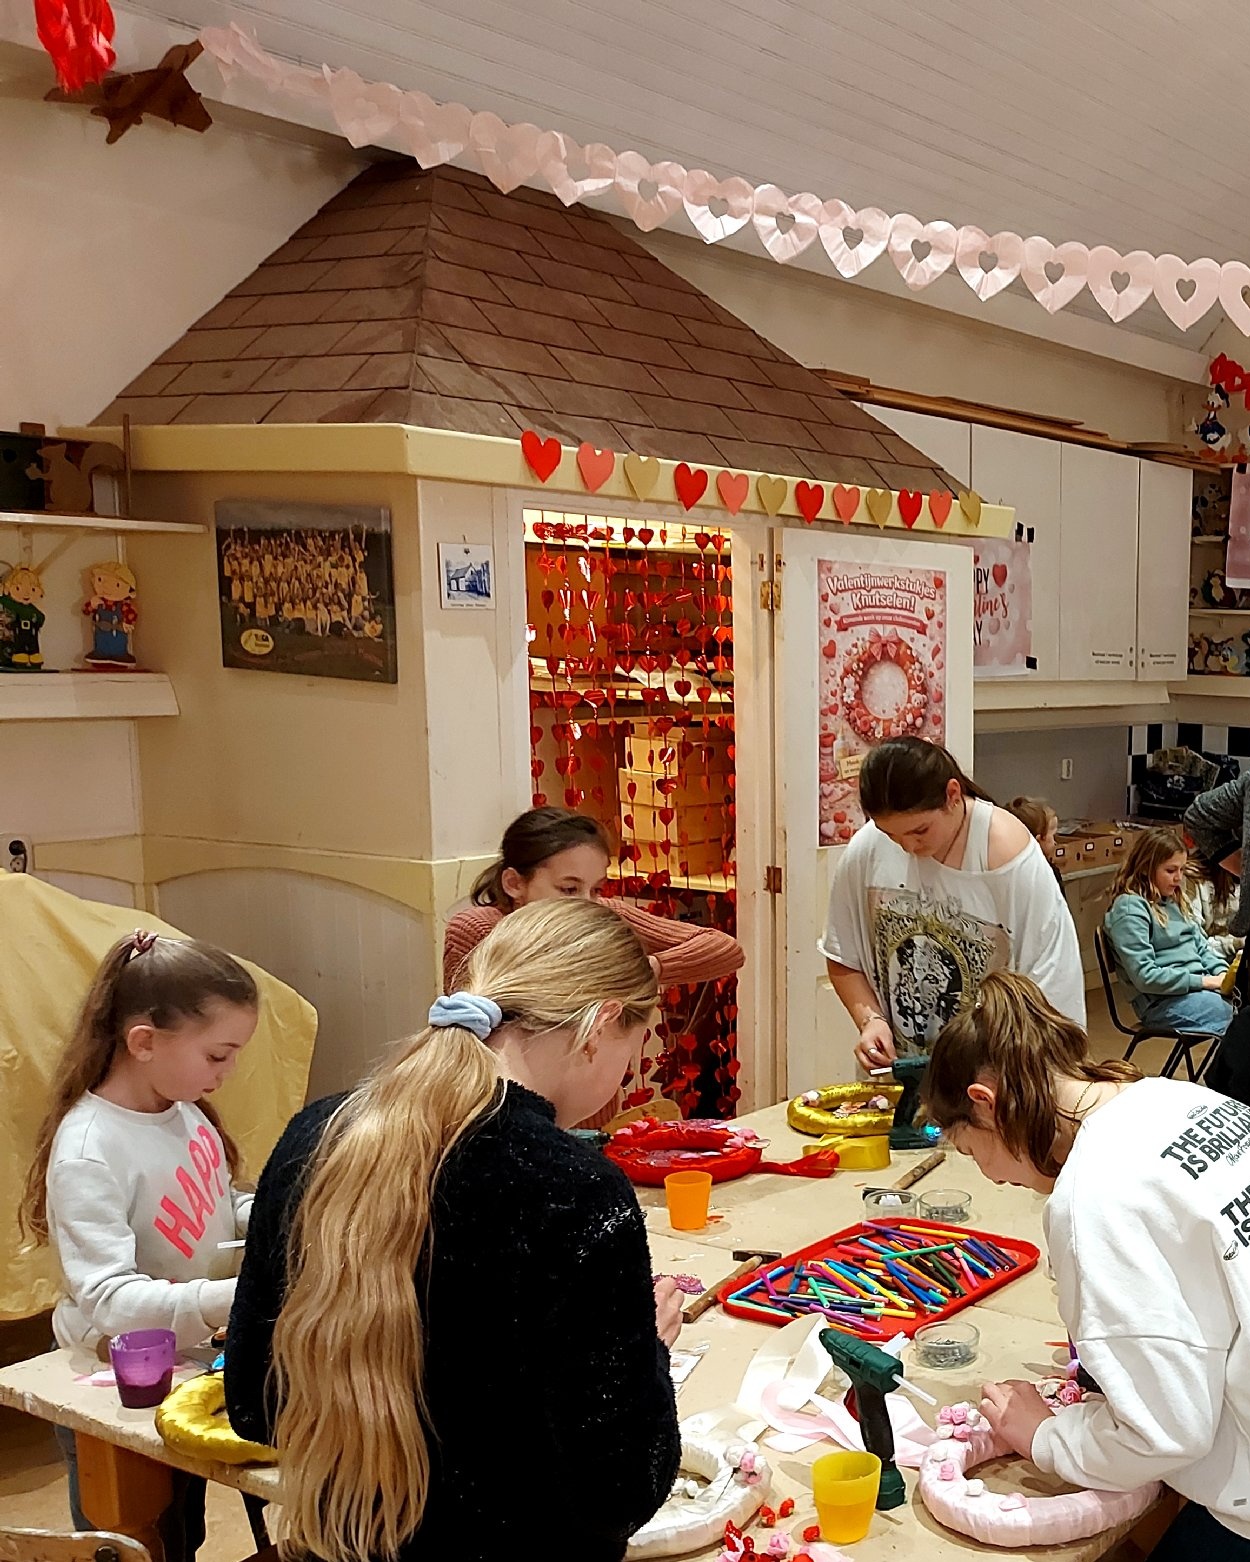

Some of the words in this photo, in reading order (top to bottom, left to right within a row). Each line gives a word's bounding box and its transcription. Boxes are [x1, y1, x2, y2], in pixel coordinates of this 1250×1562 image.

[827, 573, 936, 600] Valentijnwerkstukjes
[851, 591, 916, 613] Knutselen!
[1160, 1128, 1206, 1161] THE
[1180, 1154, 1208, 1180] IS
